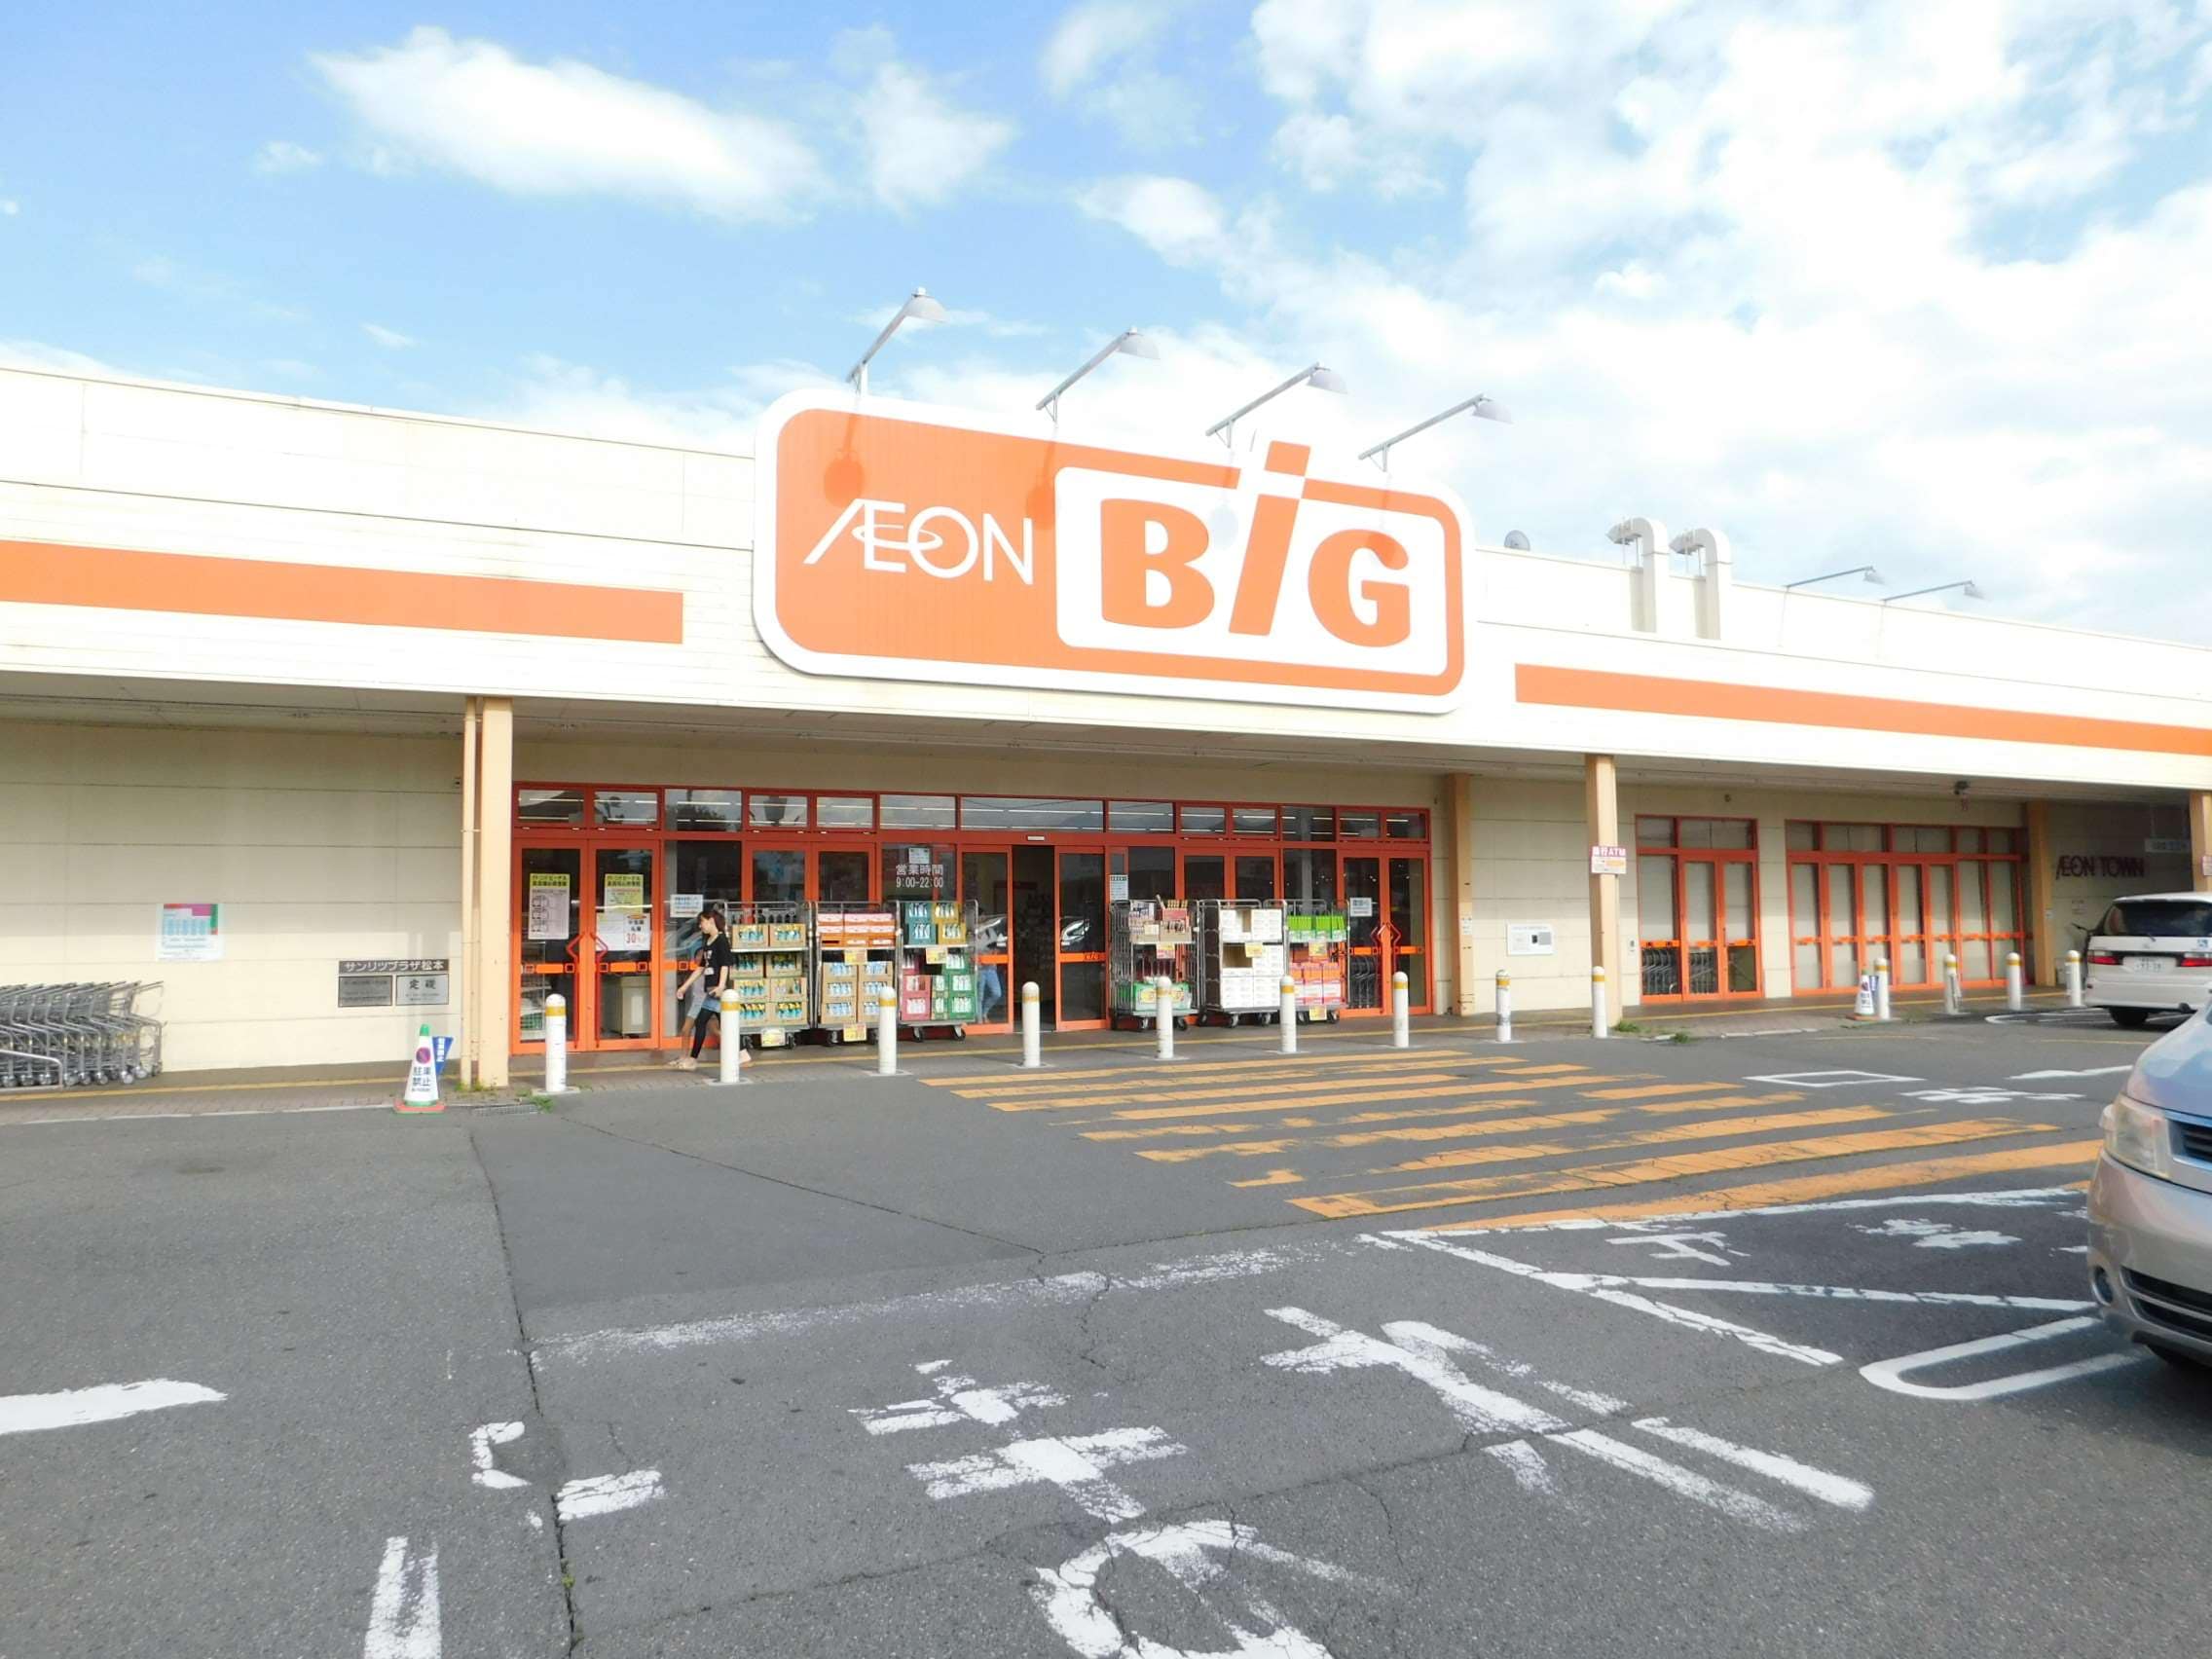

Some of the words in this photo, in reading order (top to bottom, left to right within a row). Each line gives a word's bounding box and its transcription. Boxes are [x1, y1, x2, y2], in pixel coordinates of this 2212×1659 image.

[896, 864, 943, 876] 営業時間
[2099, 856, 2146, 878] TOWN
